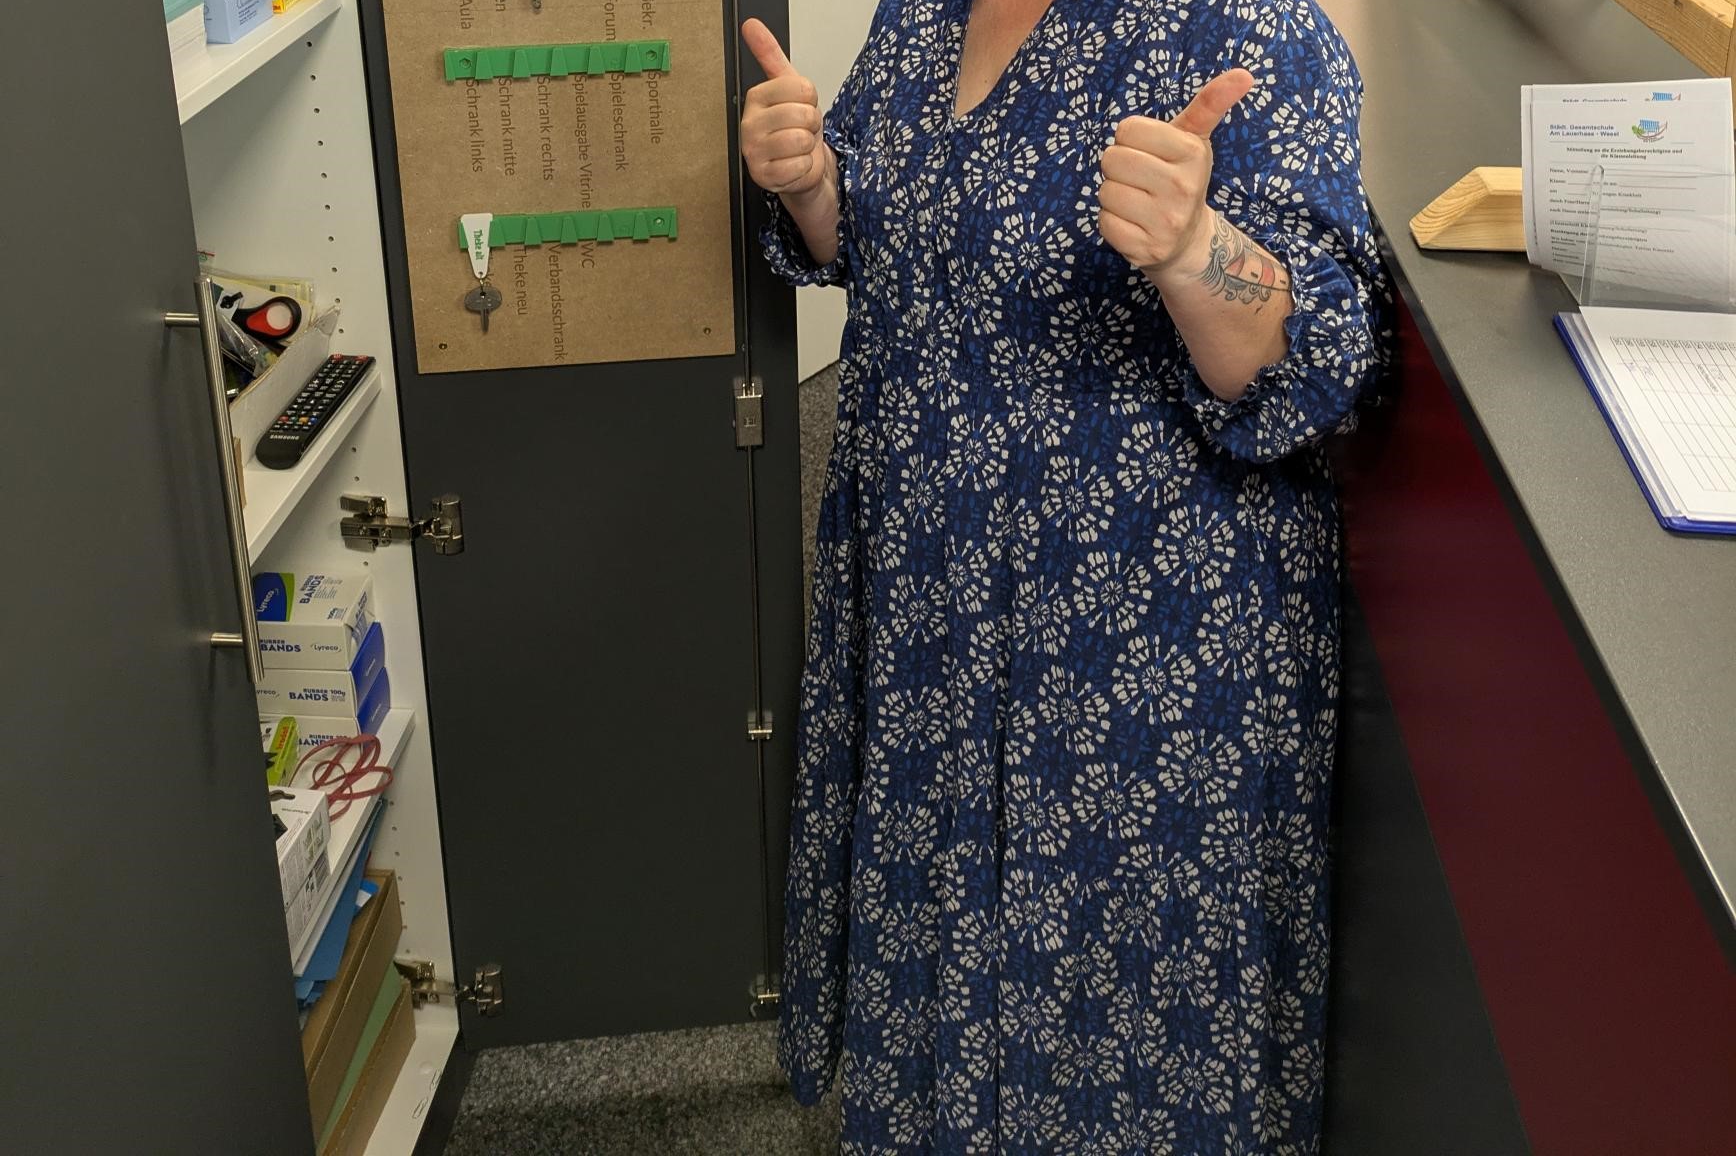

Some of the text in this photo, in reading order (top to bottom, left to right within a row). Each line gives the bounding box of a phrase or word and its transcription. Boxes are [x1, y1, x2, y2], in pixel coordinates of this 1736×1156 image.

[465, 79, 484, 173] Schrank links
[499, 77, 516, 177] Schrank mitte
[537, 76, 555, 181] Schrank rechts
[574, 74, 593, 209] Spielausgabe Vitrine
[611, 73, 628, 172] Spieleschrank
[646, 70, 663, 145] Sporthalle
[473, 229, 484, 260] Theke alt
[512, 247, 528, 316] Theke neu
[578, 242, 595, 269] WC
[548, 244, 568, 362] Verbandsschrank
[256, 589, 275, 613] Lyreco
[260, 644, 302, 653] BANDS
[288, 692, 329, 702] BANDS
